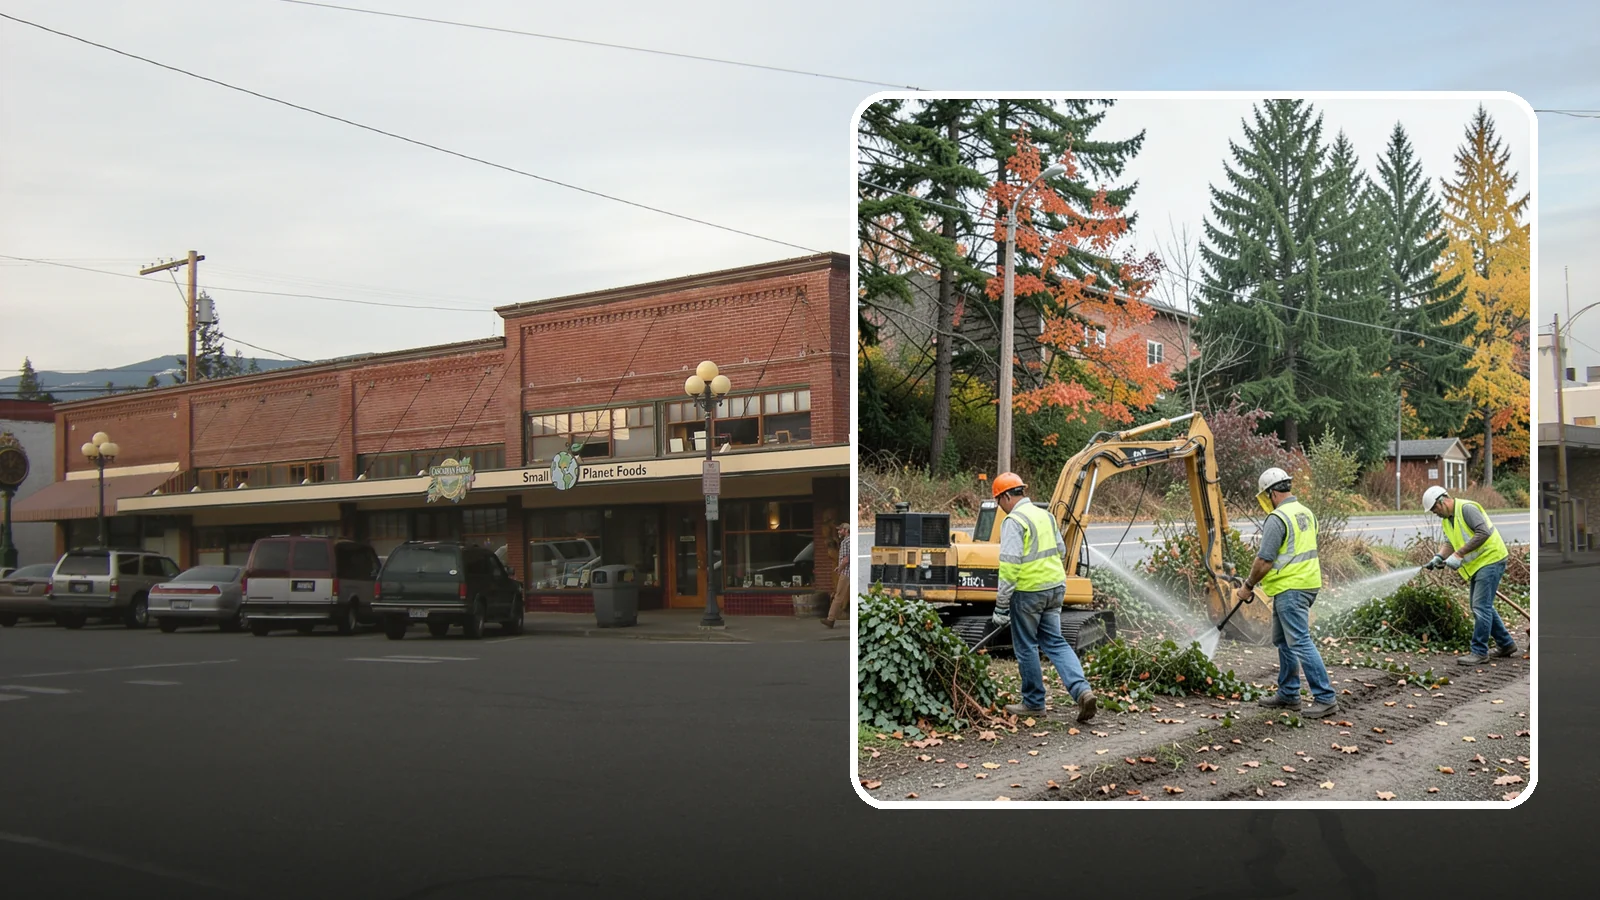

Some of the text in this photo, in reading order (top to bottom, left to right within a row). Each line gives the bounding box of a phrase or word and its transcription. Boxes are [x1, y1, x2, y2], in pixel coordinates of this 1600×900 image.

[456, 465, 470, 474] FARM
[523, 464, 647, 483] Small Planet Foods
